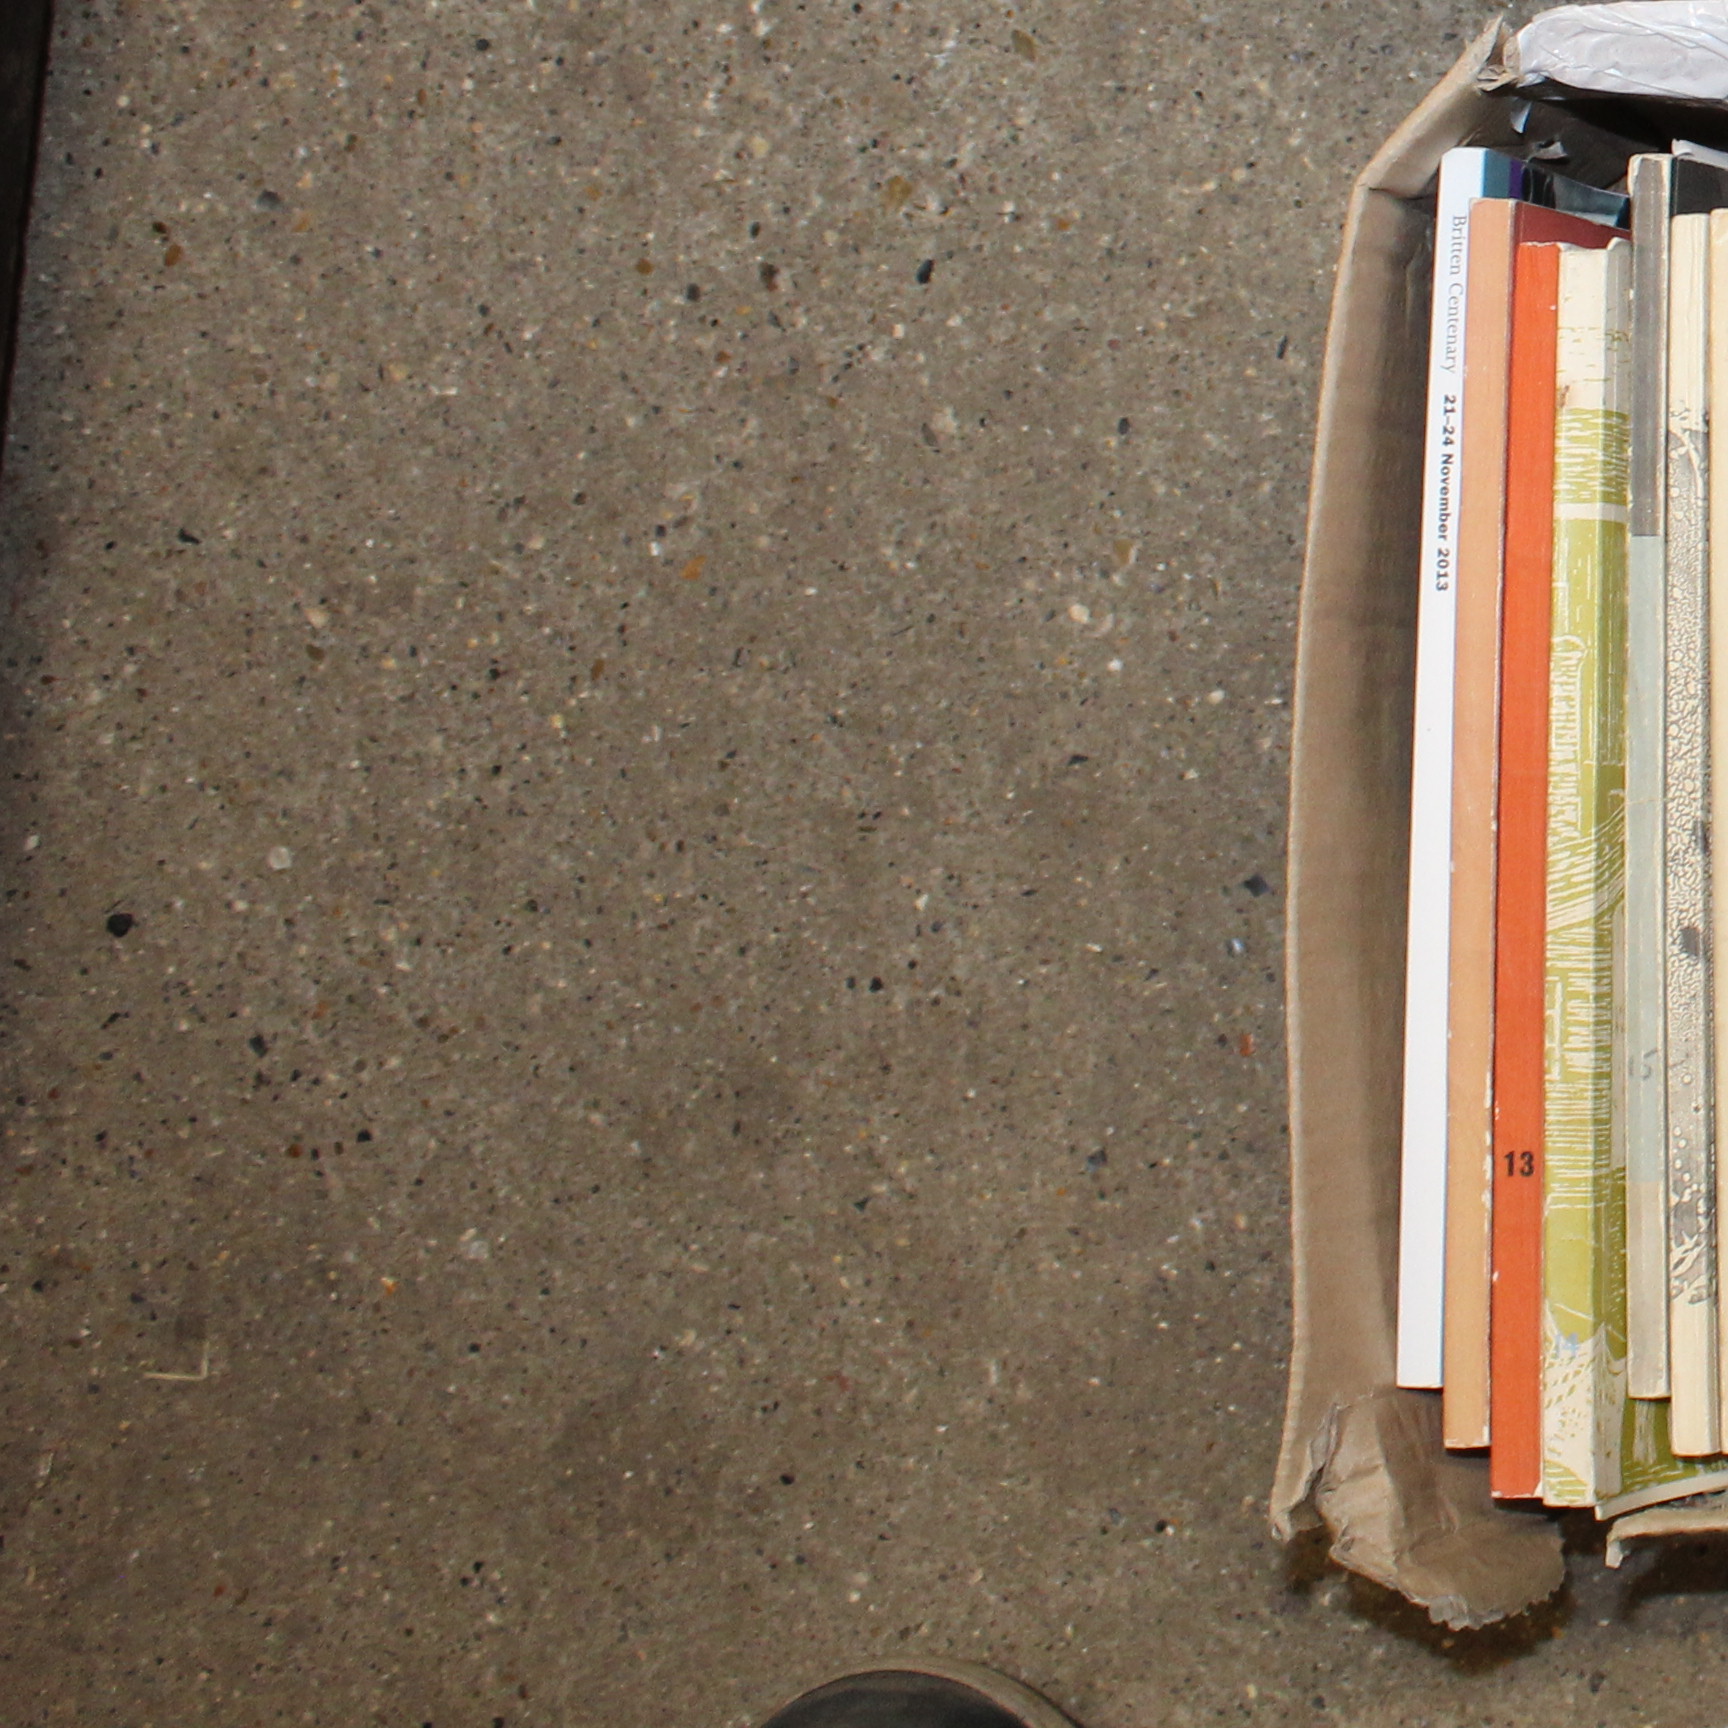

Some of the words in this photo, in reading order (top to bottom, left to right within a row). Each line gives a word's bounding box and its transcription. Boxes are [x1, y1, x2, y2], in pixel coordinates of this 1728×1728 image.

[1447, 215, 1467, 276] Britten
[1441, 282, 1465, 374] Centenary
[1441, 394, 1458, 447] 21–24
[1437, 453, 1455, 540] November
[1435, 547, 1452, 591] 2013
[1504, 1151, 1534, 1177] 13
